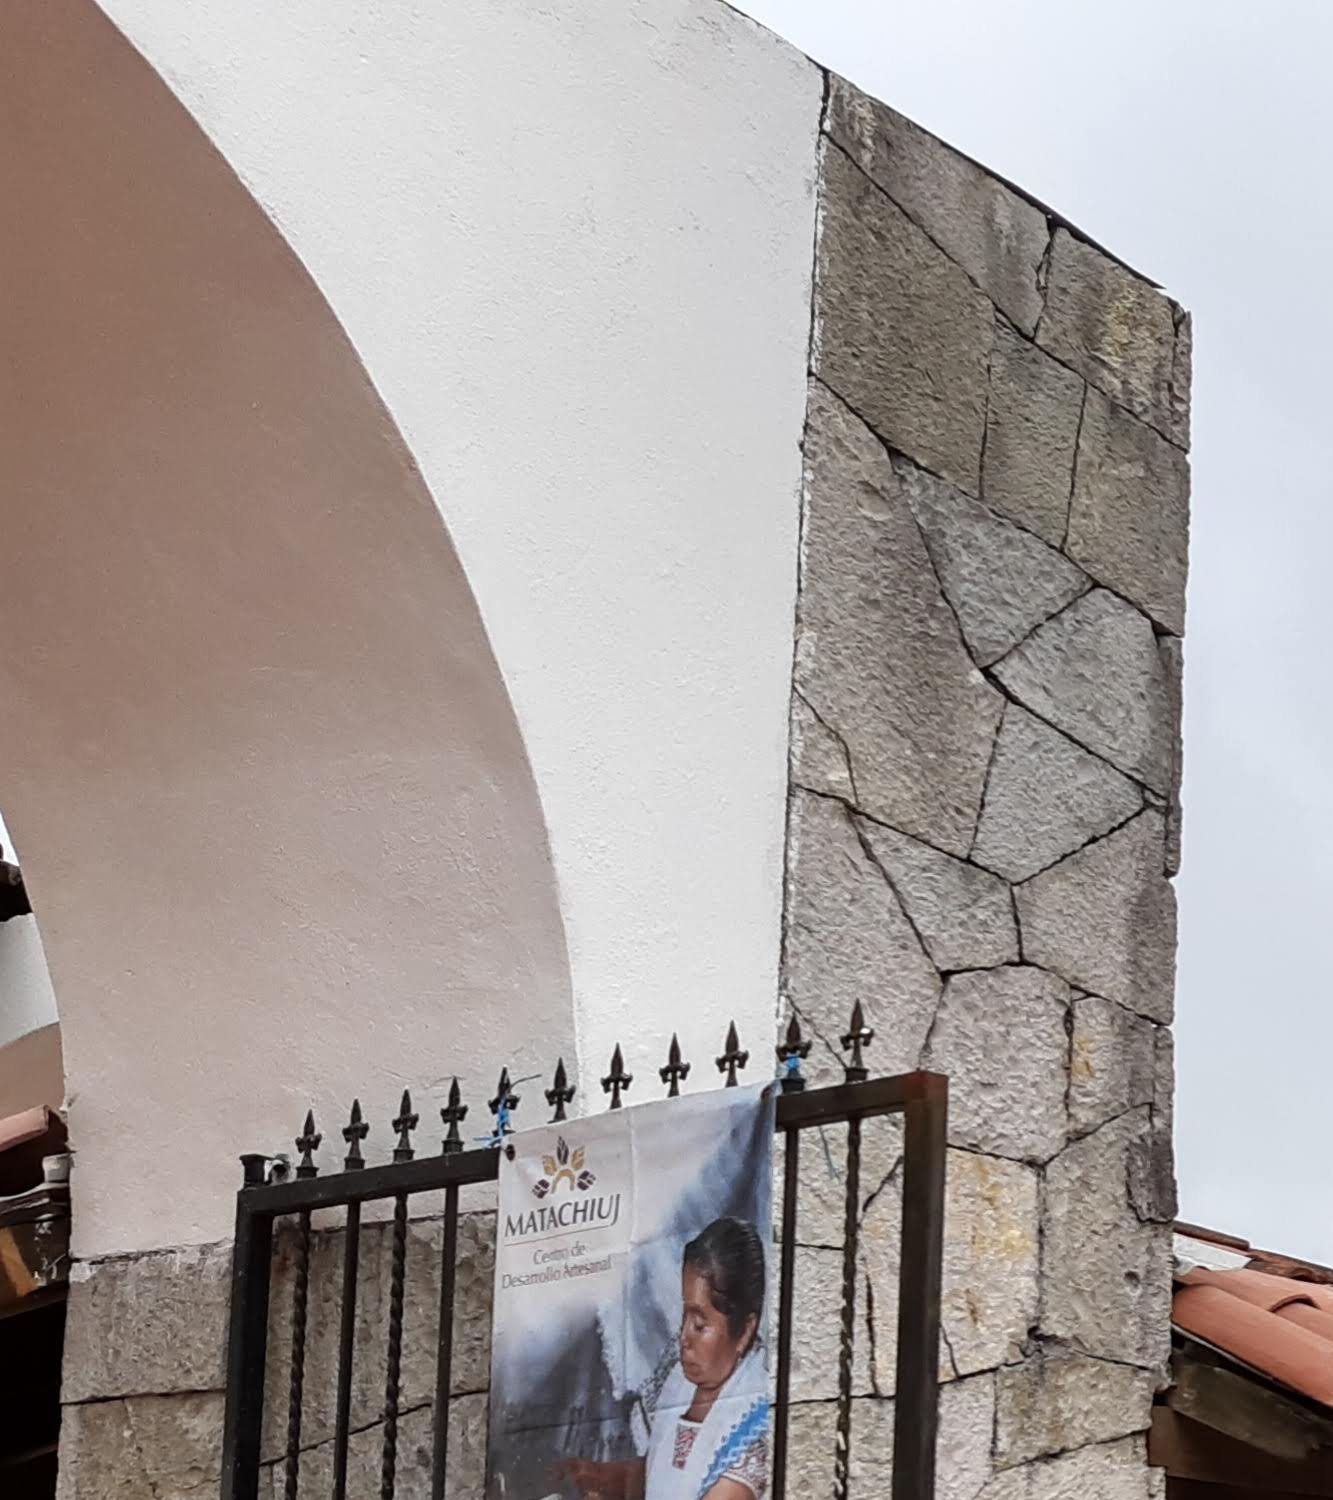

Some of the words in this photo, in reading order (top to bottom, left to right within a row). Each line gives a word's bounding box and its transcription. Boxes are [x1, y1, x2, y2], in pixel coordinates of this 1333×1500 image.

[505, 1194, 620, 1237] MATACHIUJ
[571, 1241, 586, 1256] de
[502, 1267, 561, 1289] Desarrollo
[563, 1254, 611, 1277] Artesanal
